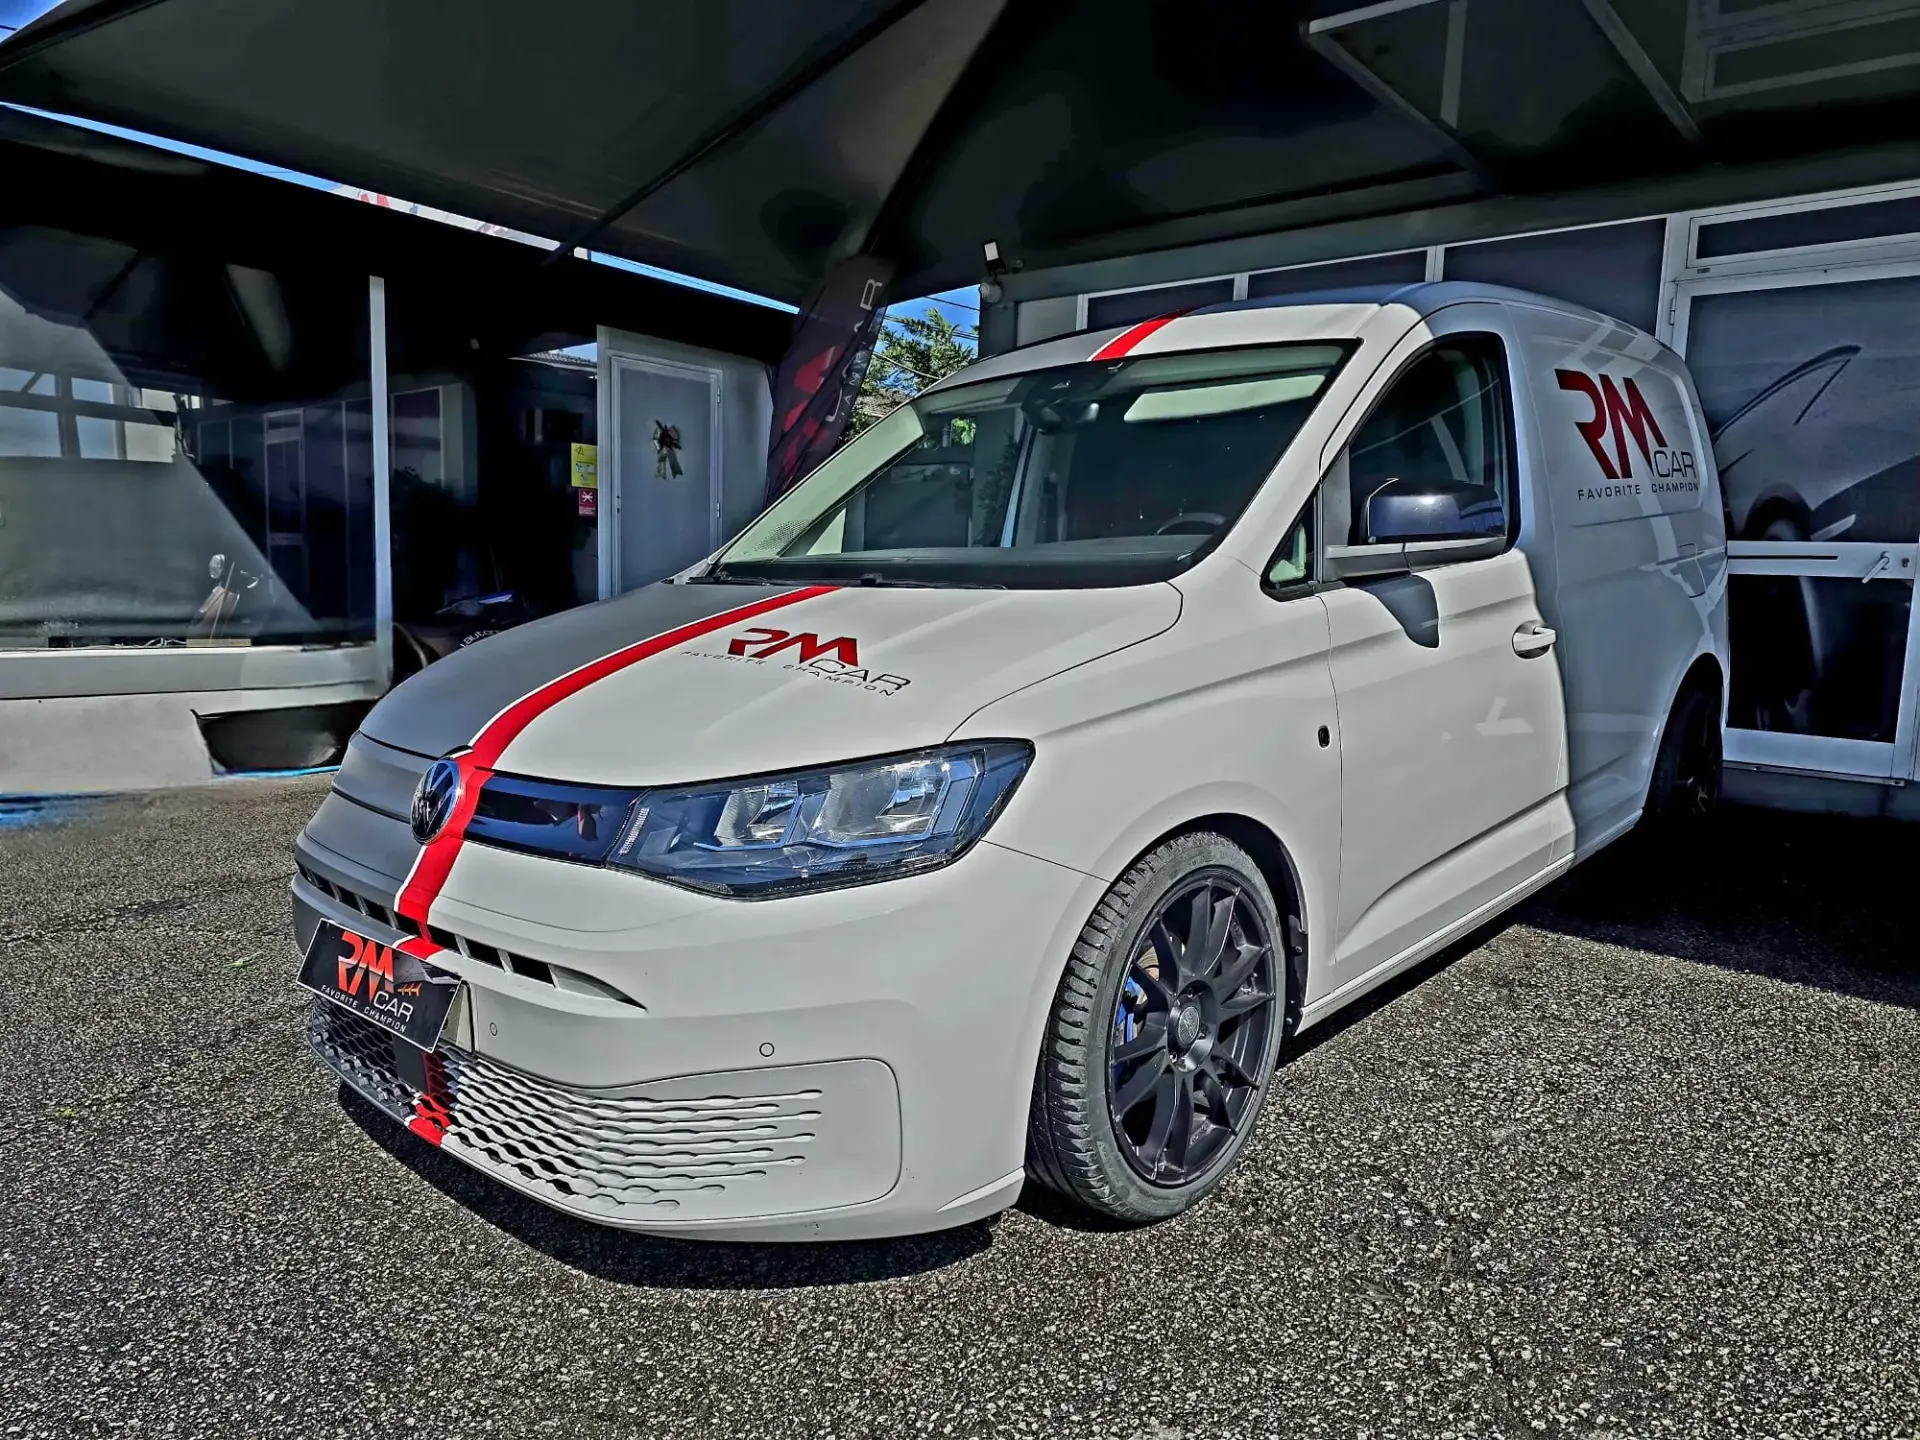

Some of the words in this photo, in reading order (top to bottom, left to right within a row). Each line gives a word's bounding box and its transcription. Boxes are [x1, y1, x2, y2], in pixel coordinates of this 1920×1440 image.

[1554, 368, 1668, 479] RM
[1653, 450, 1697, 479] CAR
[1578, 484, 1641, 501] FAVORITE
[1651, 483, 1699, 493] CHAMPION
[680, 651, 767, 665] FAVORITE
[783, 664, 894, 697] CHAMPION
[727, 627, 859, 666] RM
[808, 658, 912, 691] CAR
[337, 930, 395, 1002] RM
[373, 990, 414, 1022] CAR
[321, 984, 358, 1009] FAVORITE
[363, 1006, 407, 1034] CHAMPION
